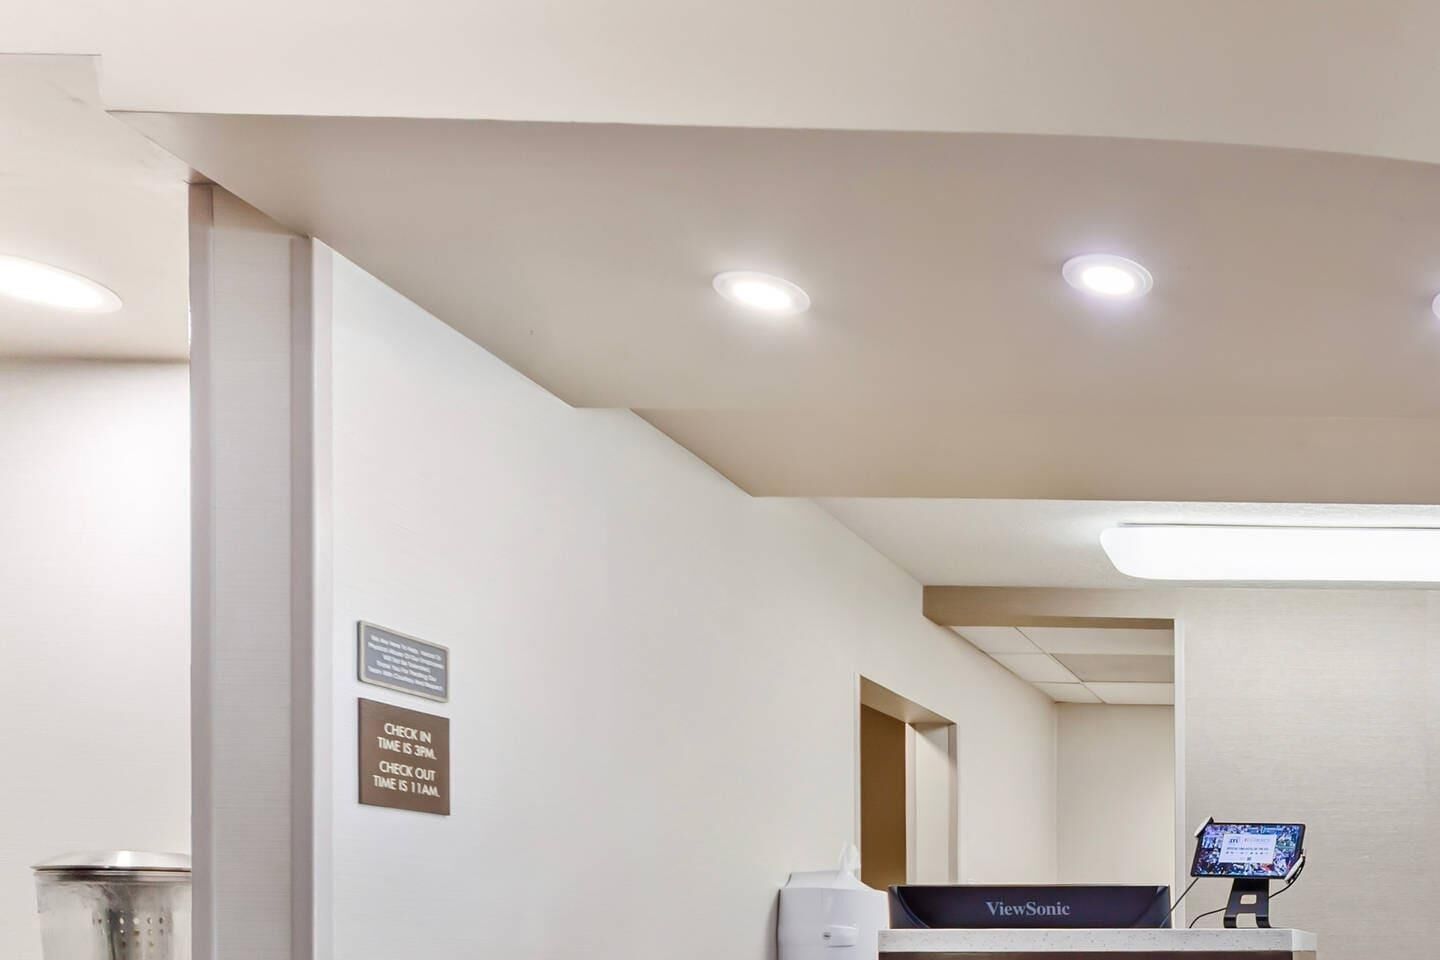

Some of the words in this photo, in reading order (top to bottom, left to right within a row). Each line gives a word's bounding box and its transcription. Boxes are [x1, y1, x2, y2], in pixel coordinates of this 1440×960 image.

[383, 722, 418, 741] CHECK
[420, 730, 432, 744] IN
[376, 736, 401, 753] TIME
[403, 742, 412, 755] IS
[379, 760, 414, 778] CHECK
[414, 767, 436, 781] OUT
[372, 774, 397, 790] TIME
[399, 780, 408, 792] IS
[985, 901, 1071, 916] ViewSonic
